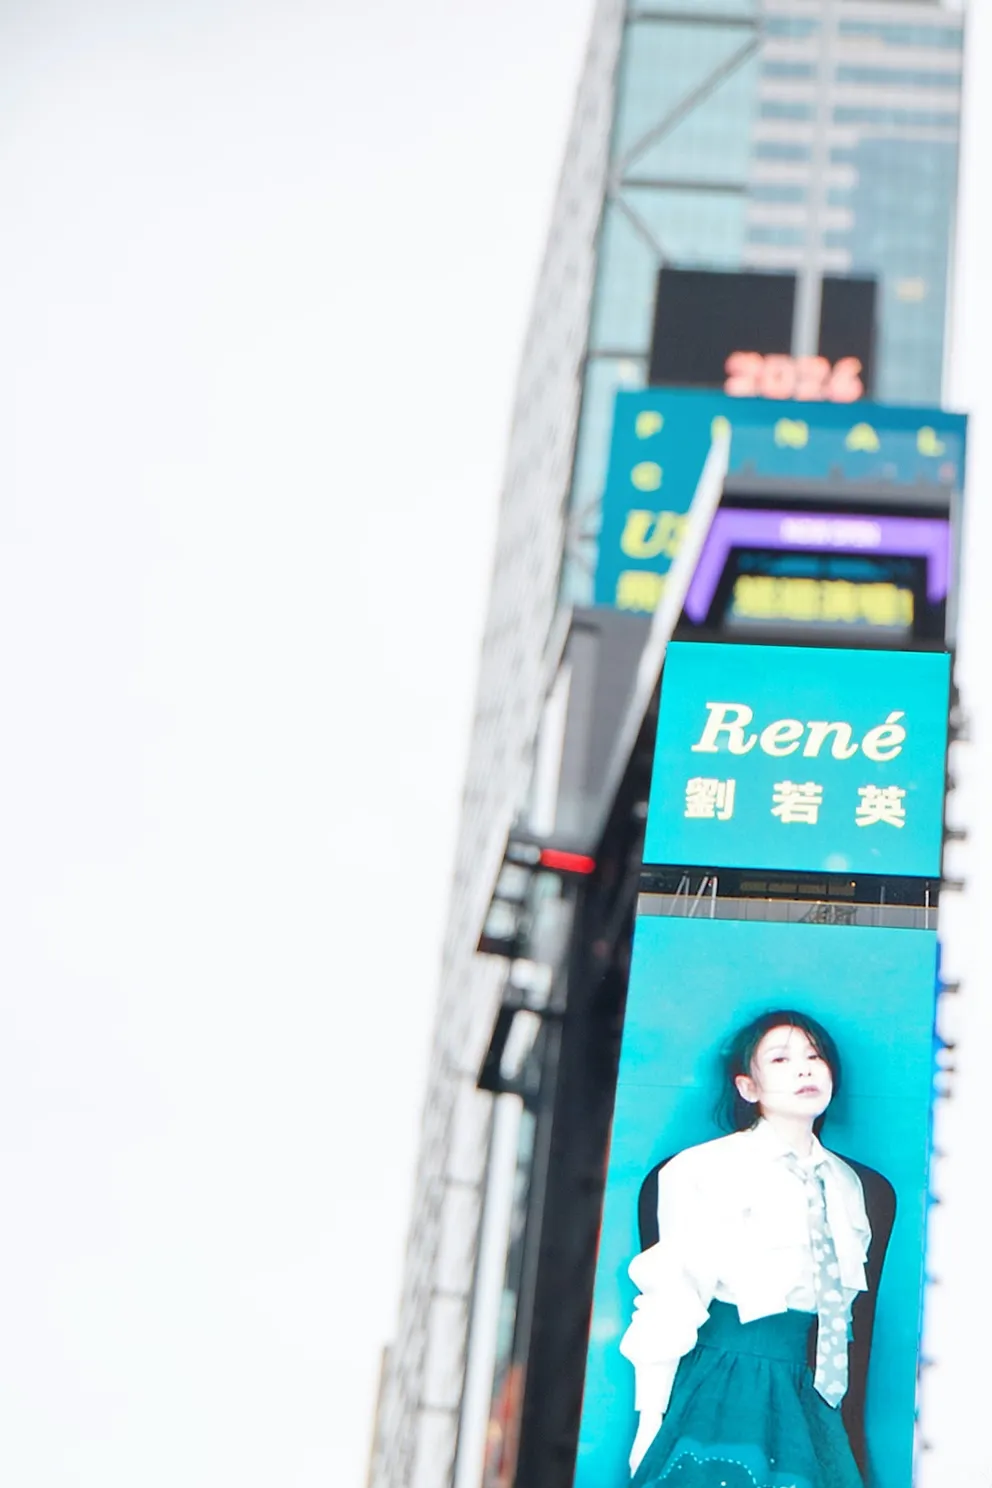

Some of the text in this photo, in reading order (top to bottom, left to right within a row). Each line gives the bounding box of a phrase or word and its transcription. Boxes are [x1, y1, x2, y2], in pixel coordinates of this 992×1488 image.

[691, 702, 905, 761] René
[684, 777, 905, 828] 劉若英
